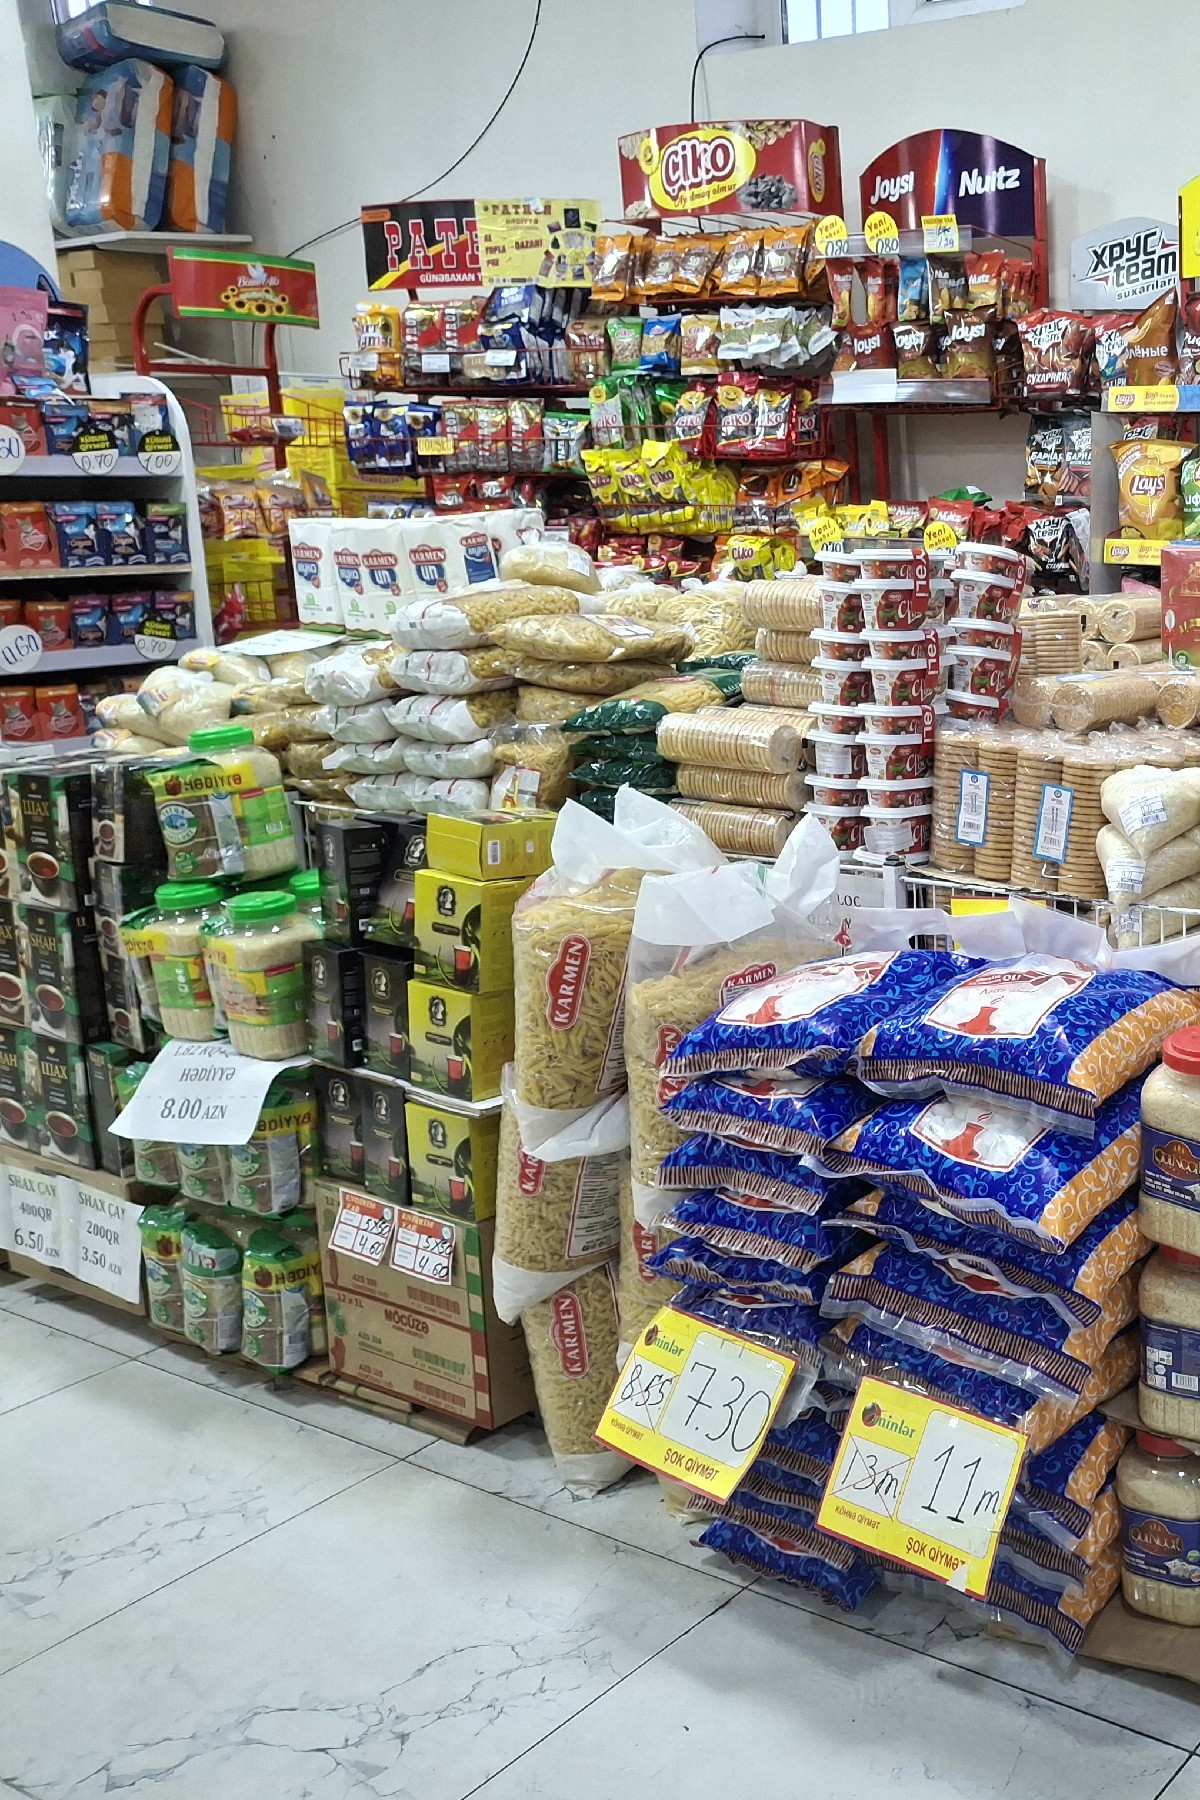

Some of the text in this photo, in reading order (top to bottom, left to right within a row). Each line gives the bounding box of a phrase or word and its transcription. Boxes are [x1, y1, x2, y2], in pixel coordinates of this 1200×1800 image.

[1112, 249, 1178, 289] team
[553, 940, 586, 1026] KARMEN
[727, 966, 775, 988] KARMEN
[179, 1065, 237, 1082] HƏDİYYƏ
[160, 1098, 228, 1120] 8.00 AZN
[8, 1174, 57, 1198] SHAX ÇAY
[19, 1201, 52, 1222] 400QR
[79, 1191, 126, 1221] SHAX ÇAY
[14, 1228, 60, 1258] 6.50 AZN
[86, 1220, 120, 1246] 200QR
[81, 1246, 122, 1276] 3.50 AZN
[558, 1296, 587, 1374] KARMEN
[685, 1361, 771, 1453] 7.30
[664, 1448, 720, 1482] ŞOK QİYMƏT
[905, 1537, 927, 1558] ŞOK
